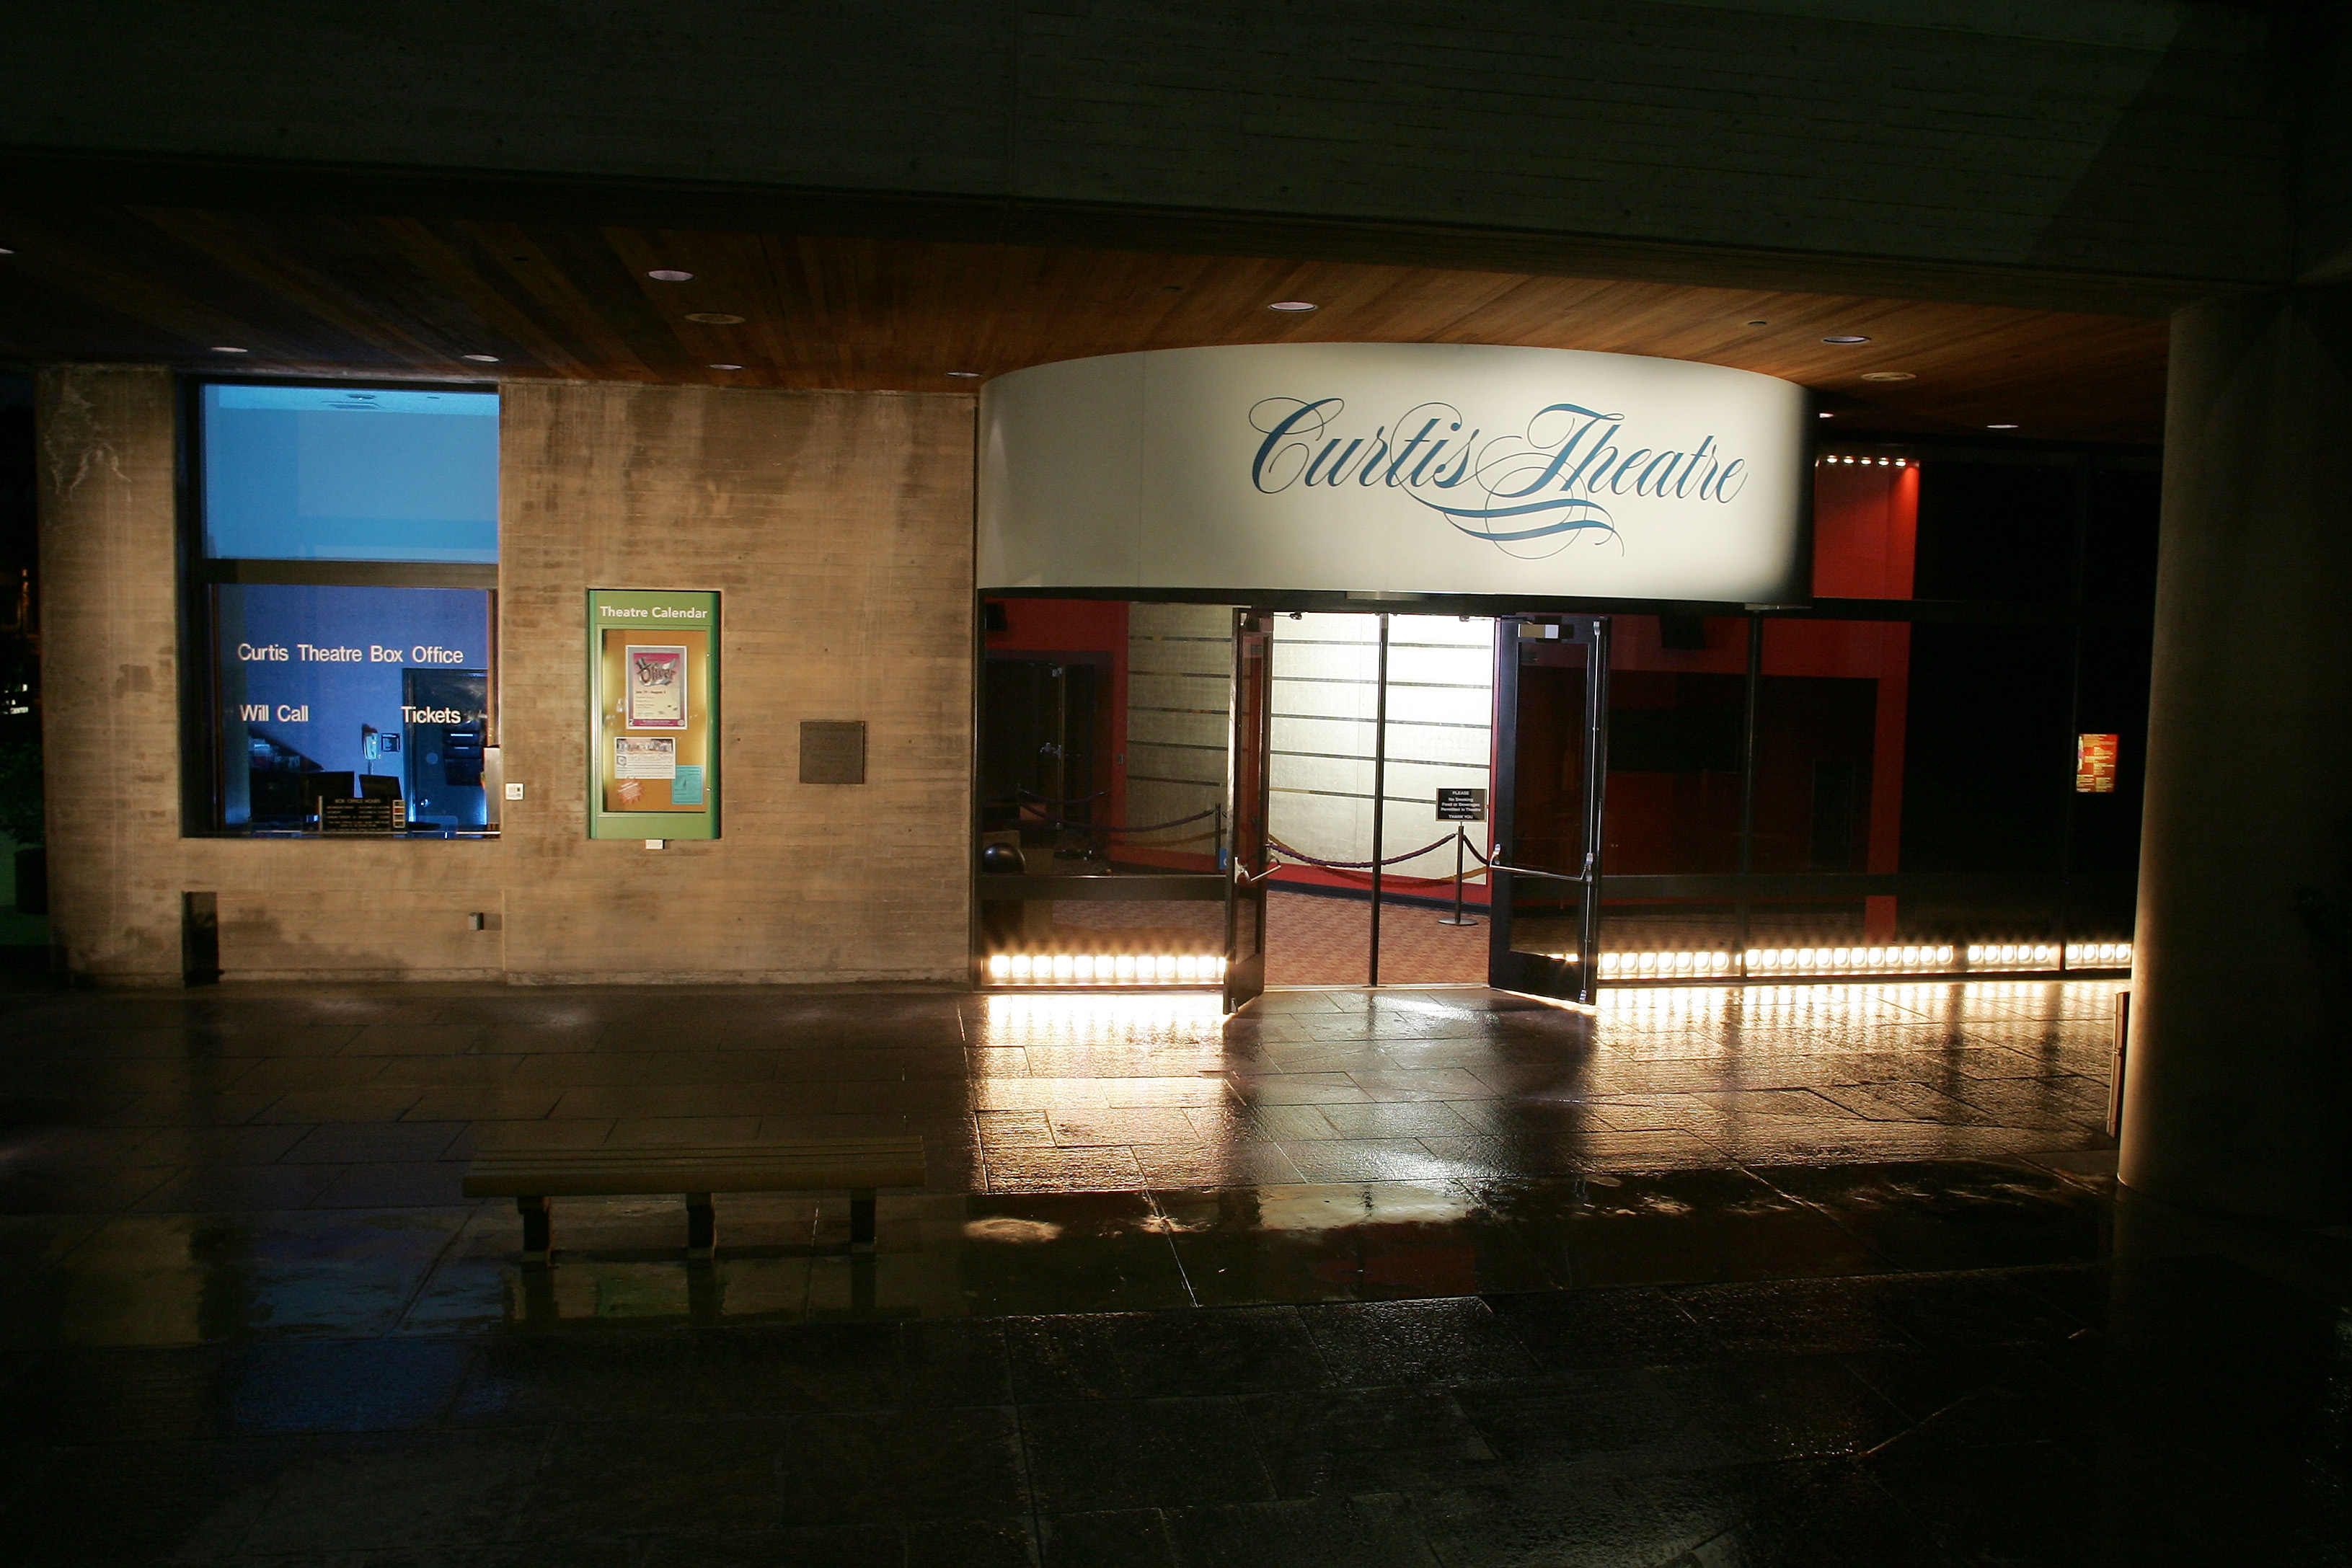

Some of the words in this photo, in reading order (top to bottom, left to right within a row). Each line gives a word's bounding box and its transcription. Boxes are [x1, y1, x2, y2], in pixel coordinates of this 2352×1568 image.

[1249, 397, 1481, 495] Curtis
[1475, 402, 1748, 506] Theatre
[600, 606, 648, 618] Theatre
[652, 606, 708, 619] Calendar
[237, 643, 289, 661] Curtis
[297, 644, 363, 663] Theatre
[370, 645, 404, 663] Box
[412, 645, 464, 663] Office
[240, 704, 270, 722] Will
[277, 705, 309, 722] Call
[401, 706, 461, 724] Tickets
